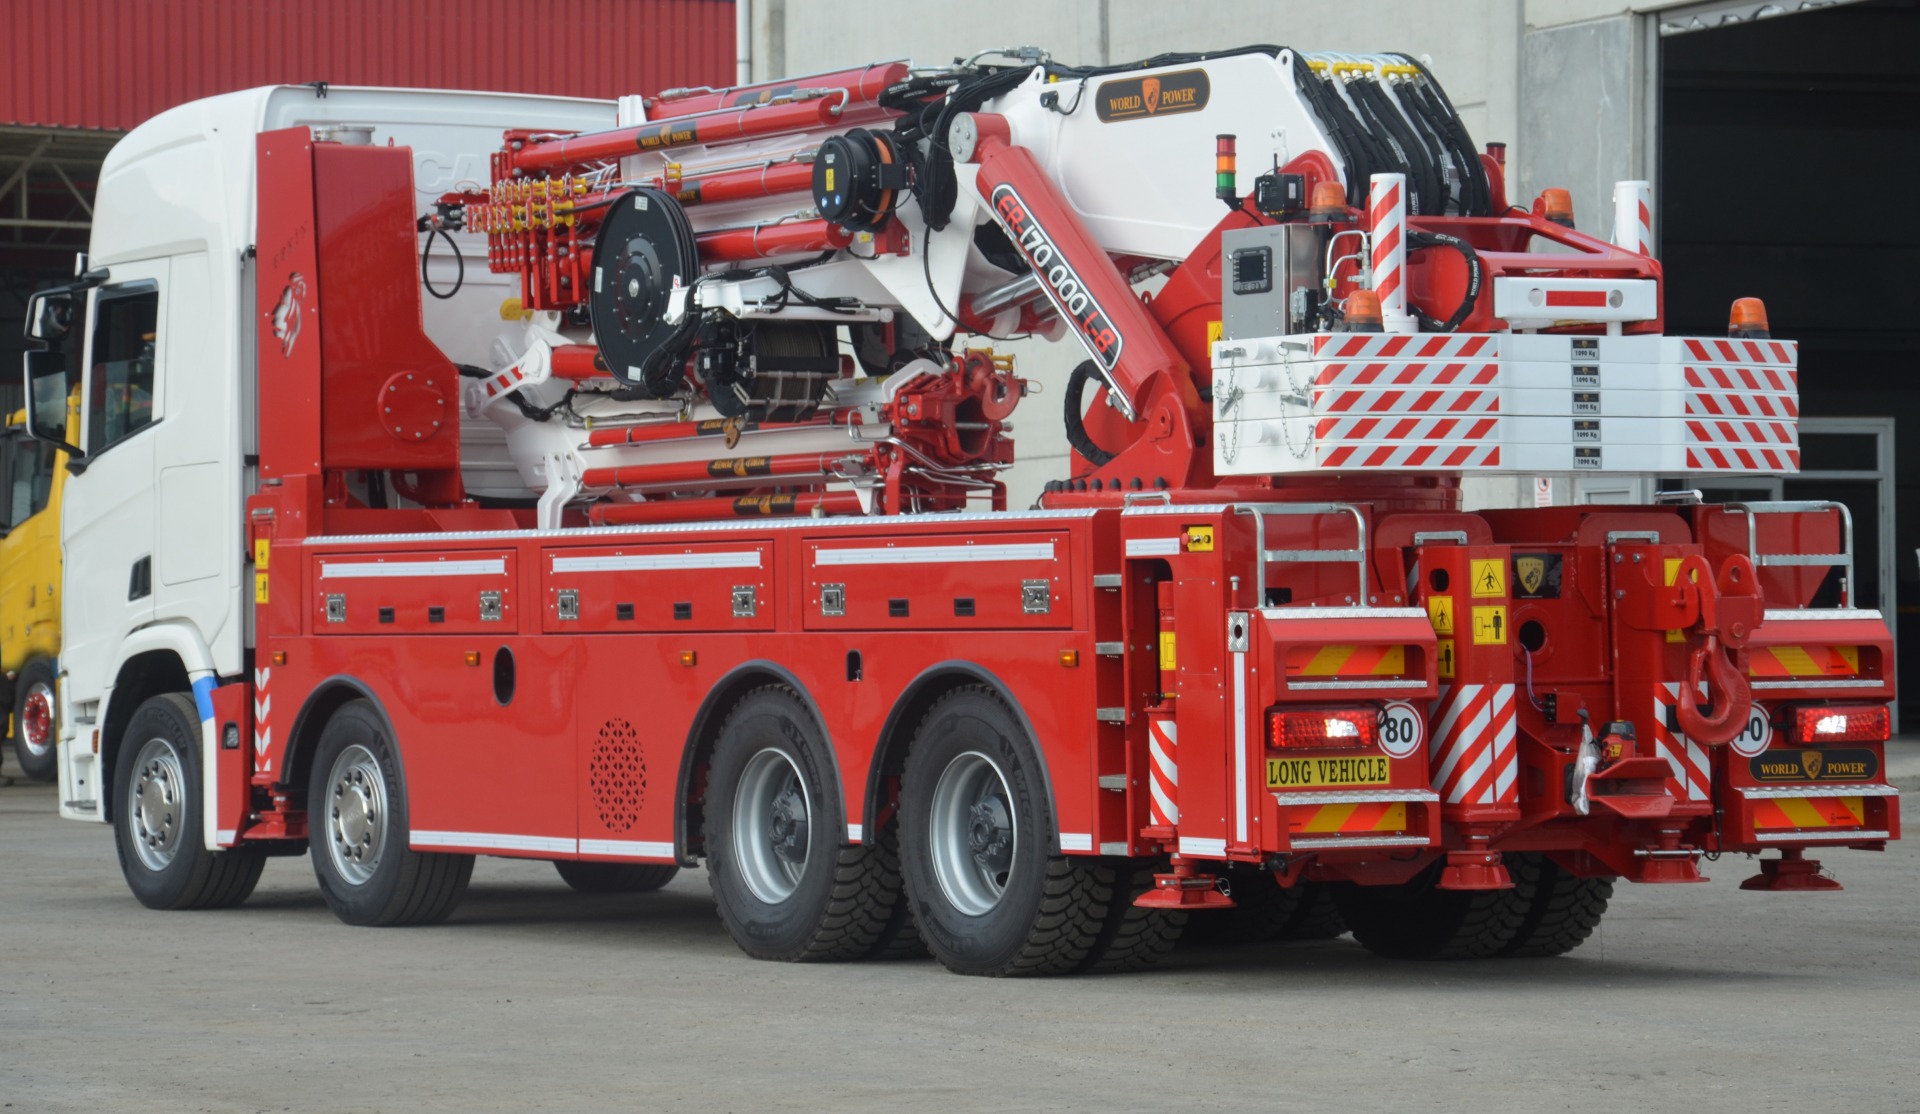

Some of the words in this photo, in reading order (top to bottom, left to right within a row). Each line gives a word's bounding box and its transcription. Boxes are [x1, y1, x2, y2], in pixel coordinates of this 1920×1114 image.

[1109, 95, 1141, 111] WORLD
[1162, 88, 1195, 105] POWER
[641, 135, 660, 147] WORLD
[671, 130, 692, 142] POWER
[1048, 265, 1088, 316] 000
[1083, 311, 1115, 354] L-8
[1385, 717, 1413, 743] 80
[1269, 760, 1312, 785] LONG
[1317, 758, 1387, 783] VEHICLE
[1761, 763, 1799, 775] WORLD
[1827, 762, 1866, 774] POWER
